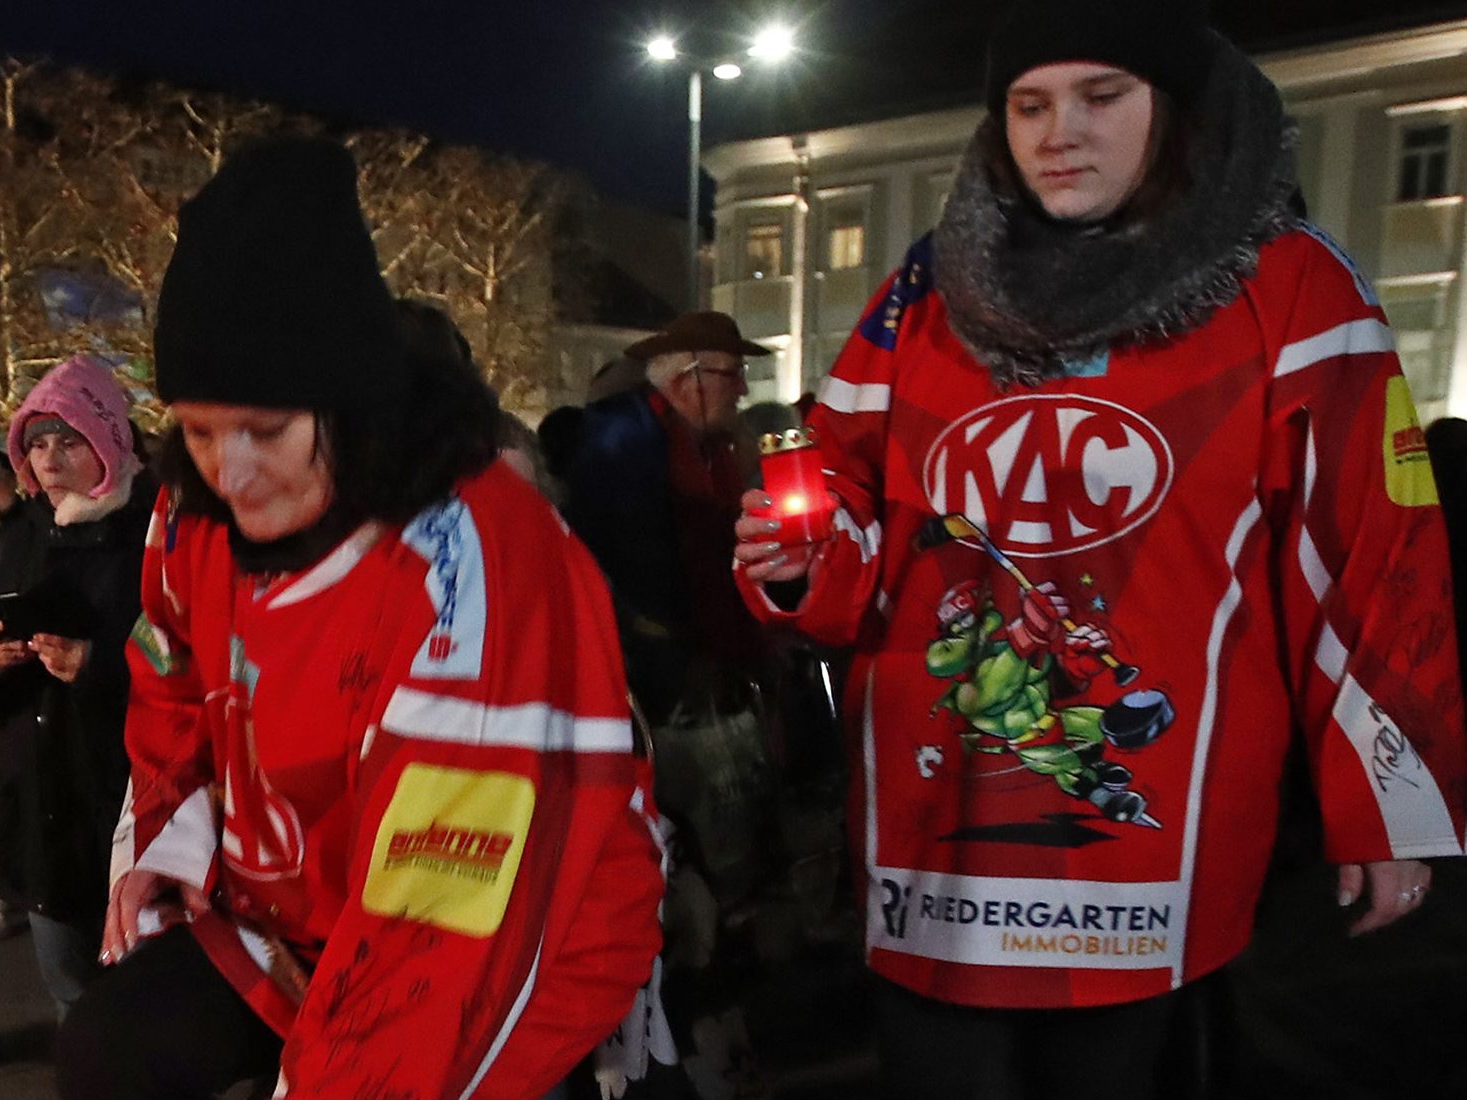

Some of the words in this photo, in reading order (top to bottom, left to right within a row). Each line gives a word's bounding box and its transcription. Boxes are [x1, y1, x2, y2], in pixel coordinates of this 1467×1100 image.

[945, 402, 1135, 547] KAC
[920, 893, 1172, 931] RIEDERGARTEN
[1000, 931, 1168, 956] IMMOBILIEN
